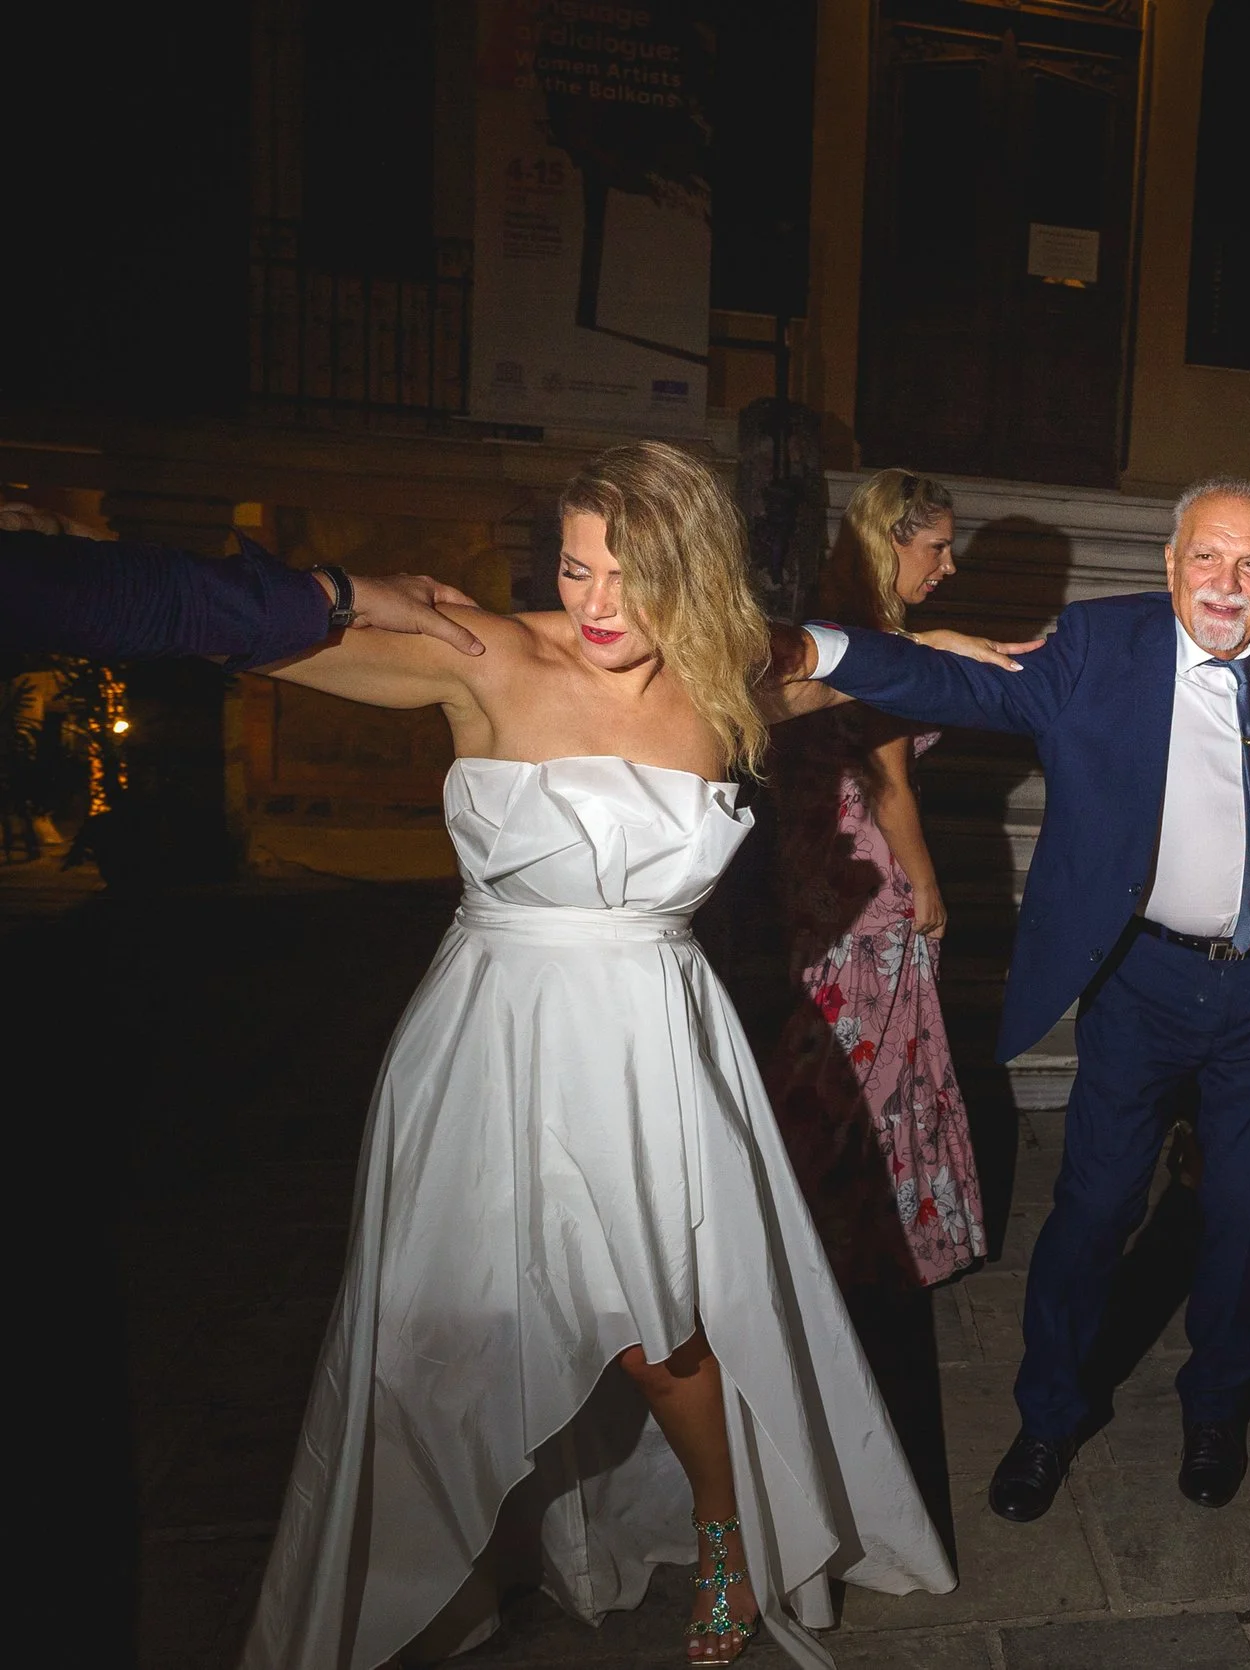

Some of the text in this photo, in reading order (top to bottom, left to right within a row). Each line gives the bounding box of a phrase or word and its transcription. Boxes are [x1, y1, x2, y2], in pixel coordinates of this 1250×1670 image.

[549, 23, 681, 62] dialogue:
[514, 49, 682, 89] Women Artists
[544, 76, 583, 96] the
[588, 80, 681, 109] Balkans
